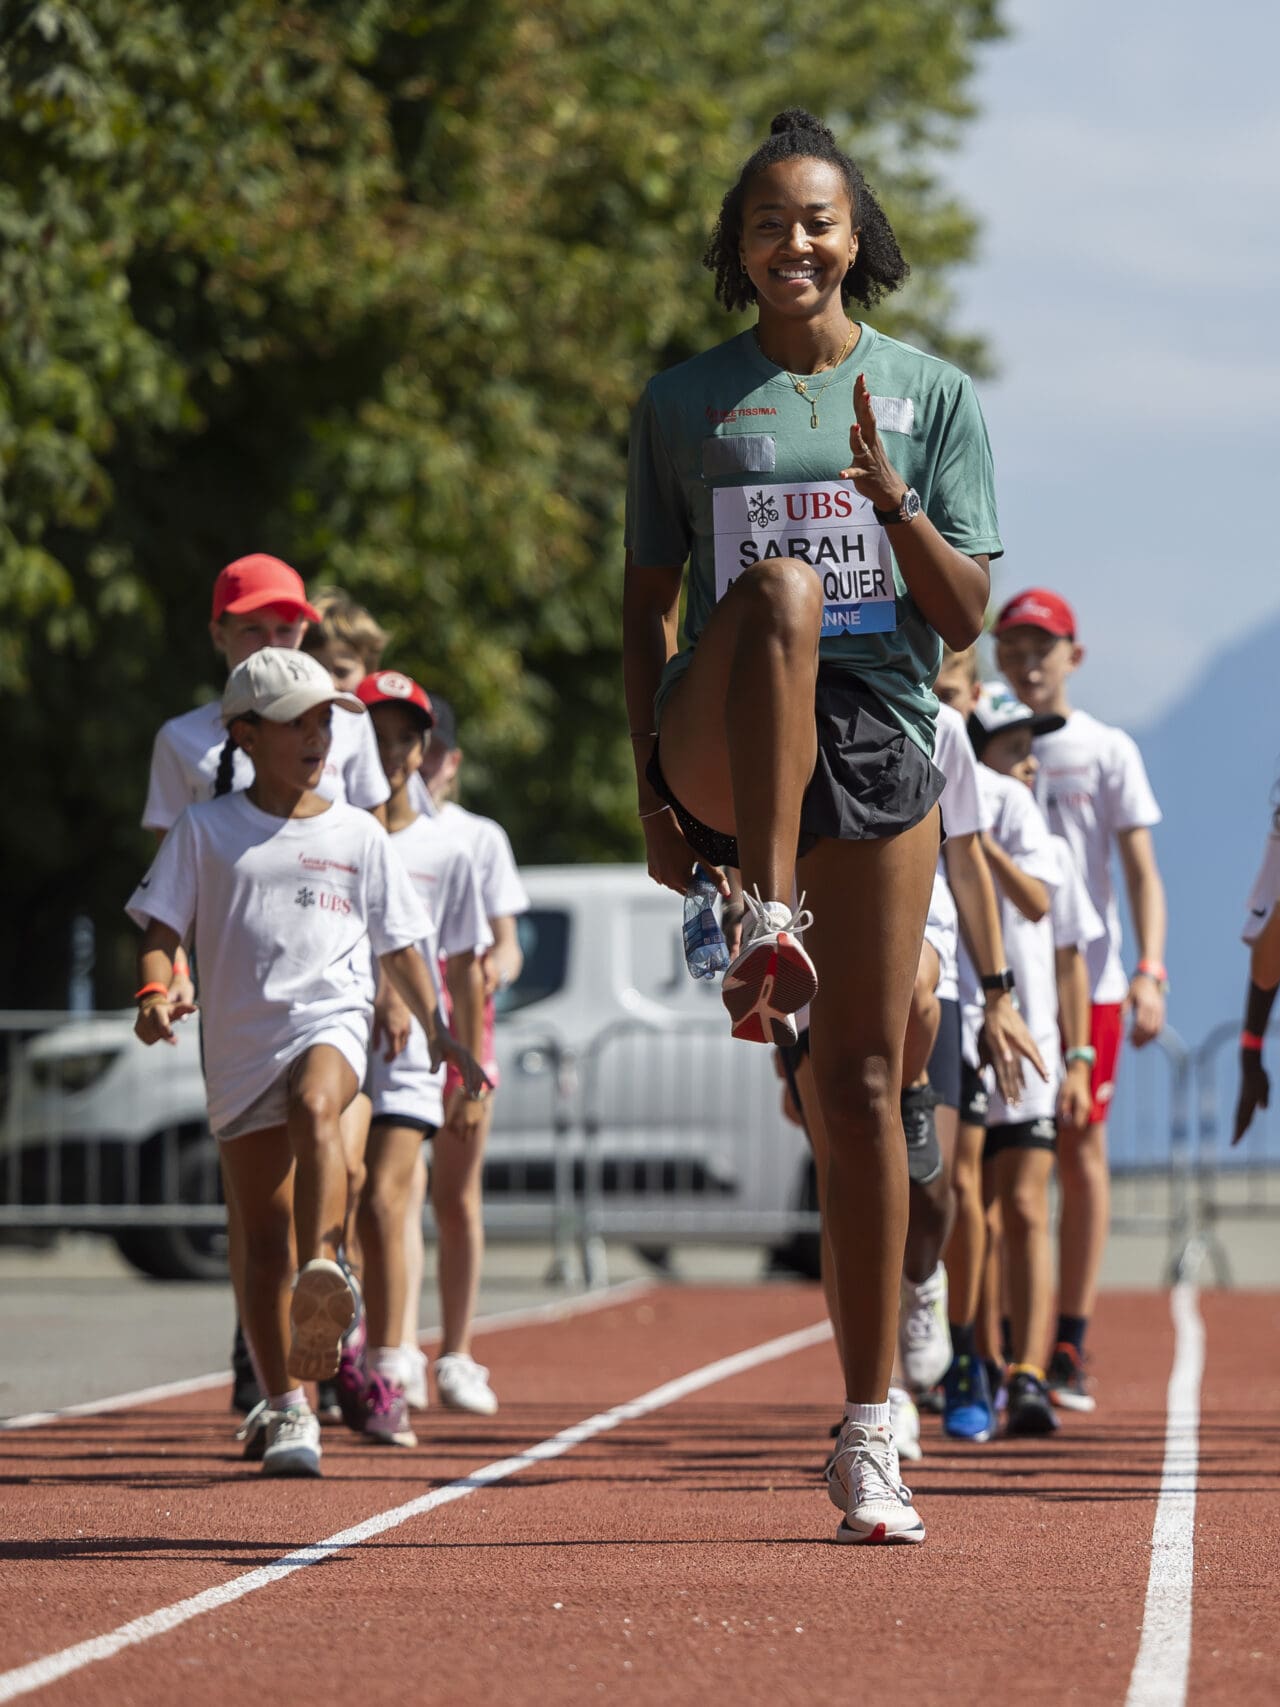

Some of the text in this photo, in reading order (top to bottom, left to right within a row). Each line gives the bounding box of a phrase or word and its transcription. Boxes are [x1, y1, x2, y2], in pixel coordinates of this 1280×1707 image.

[783, 490, 853, 522] UBS
[739, 533, 866, 569] SARAH
[823, 569, 887, 600] QUIER
[821, 610, 861, 627] NNE
[320, 892, 352, 914] UBS
